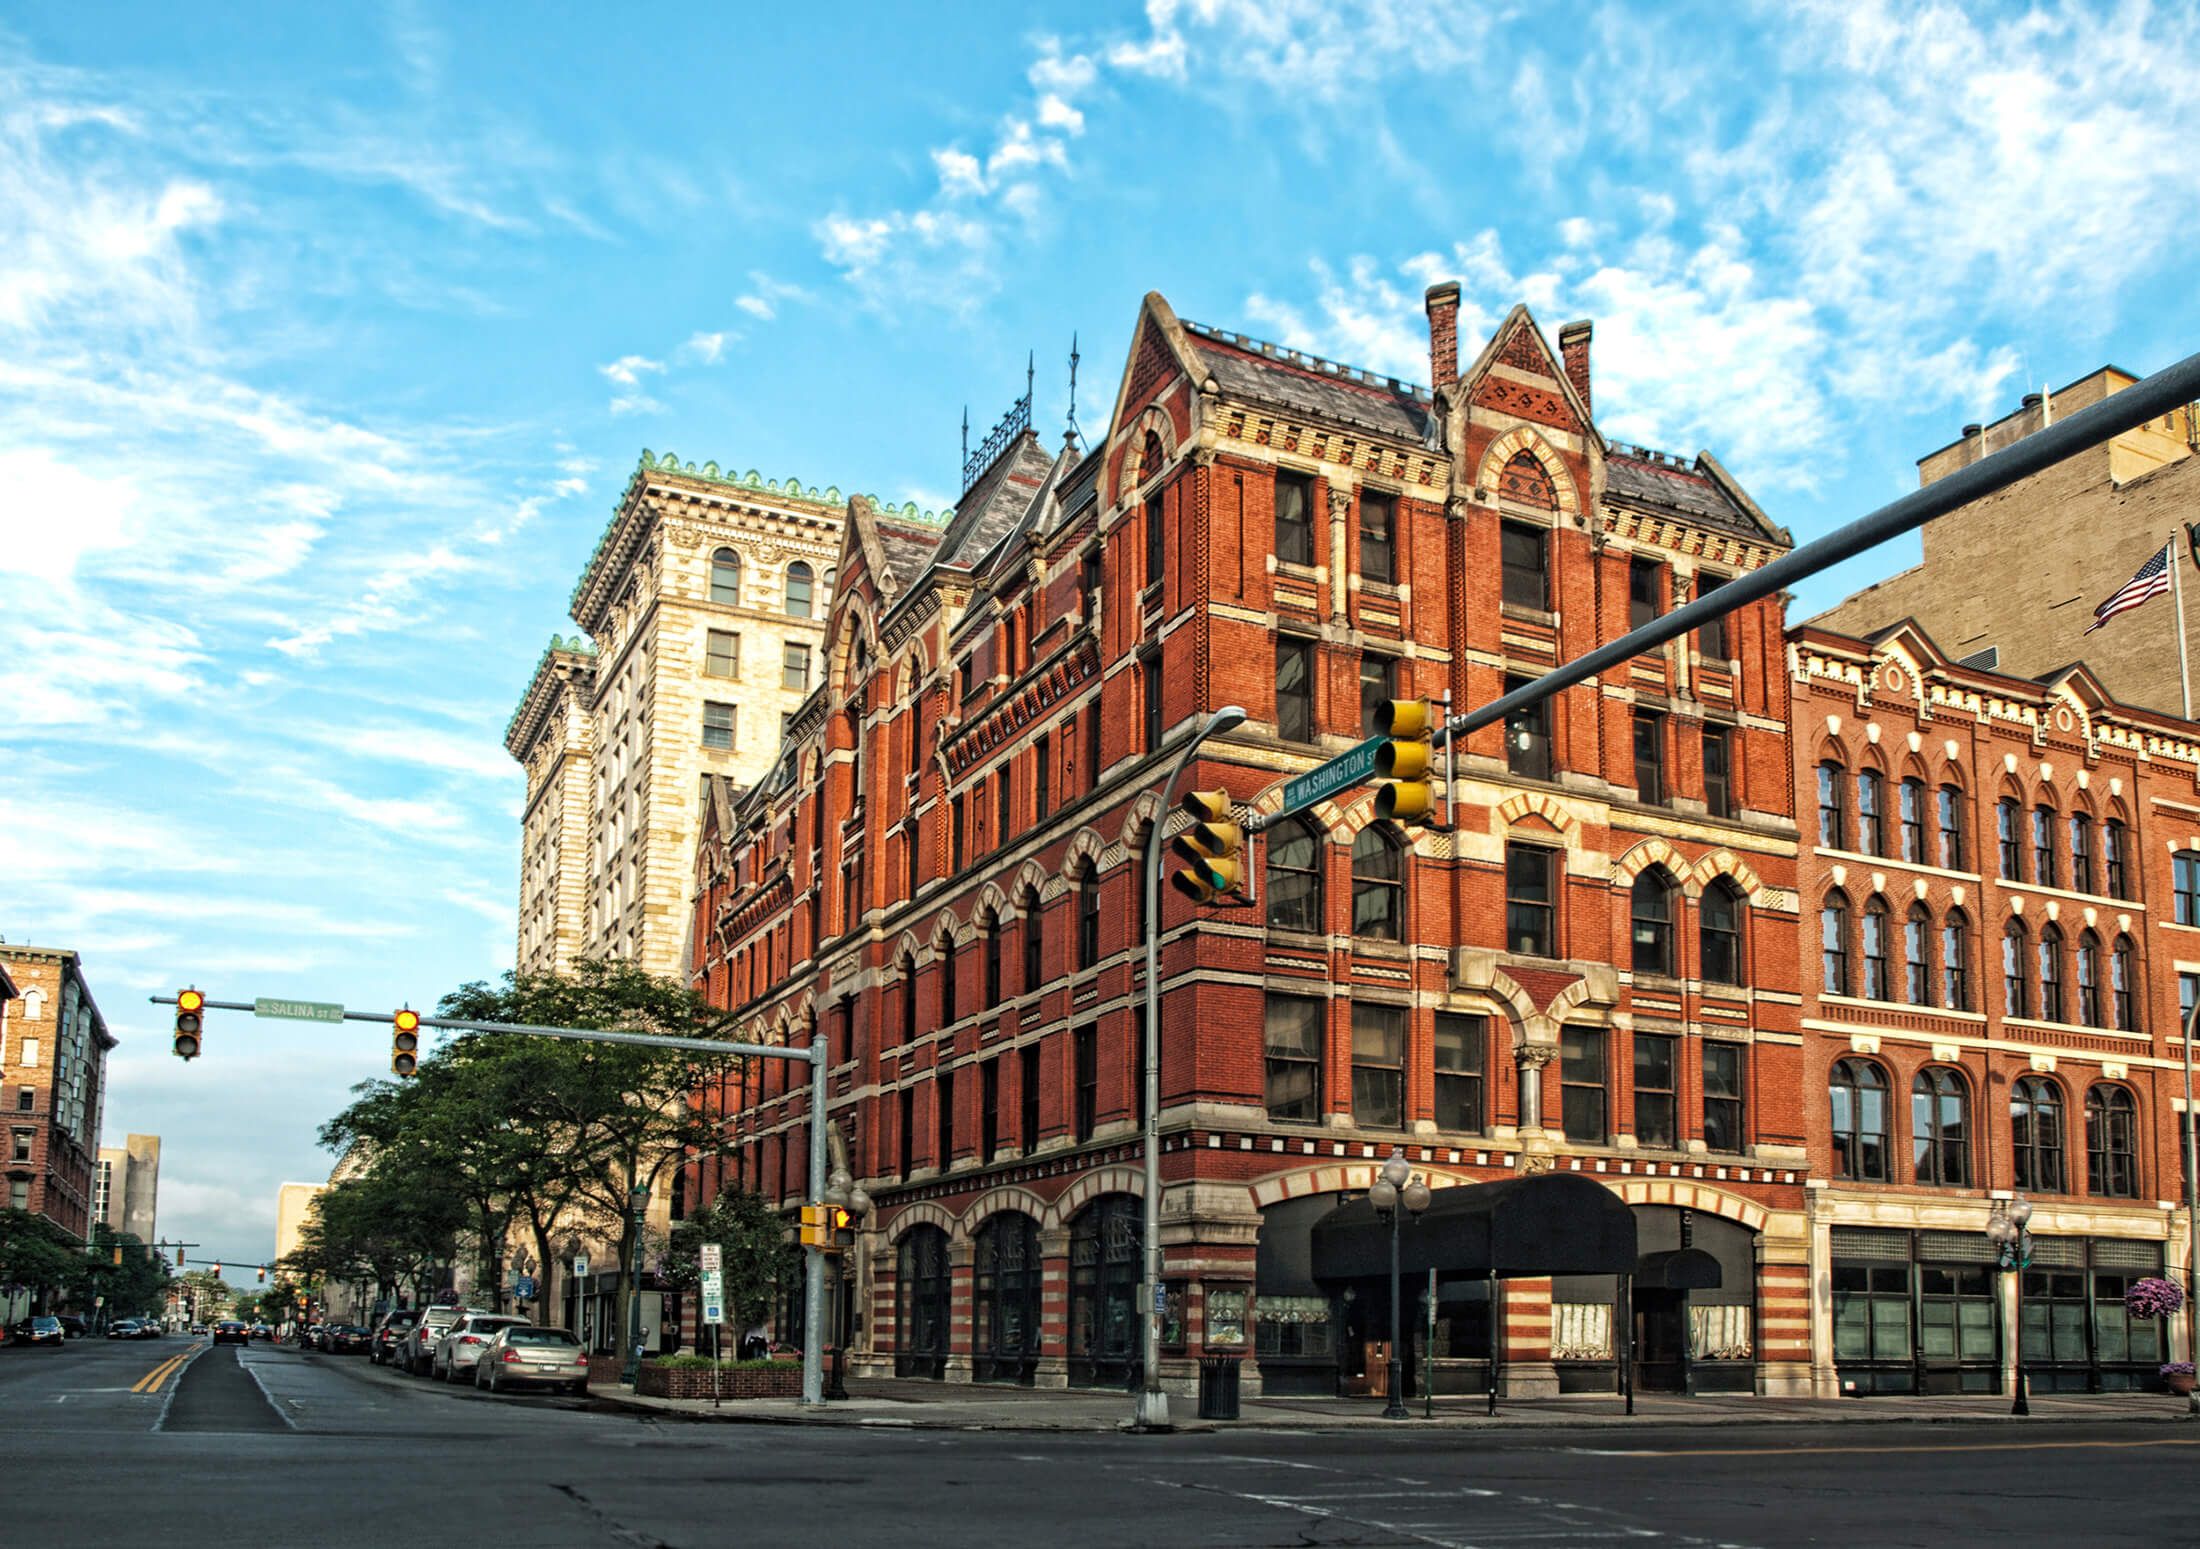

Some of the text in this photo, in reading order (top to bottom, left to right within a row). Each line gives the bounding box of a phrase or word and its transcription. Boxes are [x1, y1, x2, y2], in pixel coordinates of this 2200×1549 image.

[1297, 750, 1365, 801] WASHINGTON
[271, 1002, 315, 1017] SALINA
[316, 1009, 328, 1018] ST
